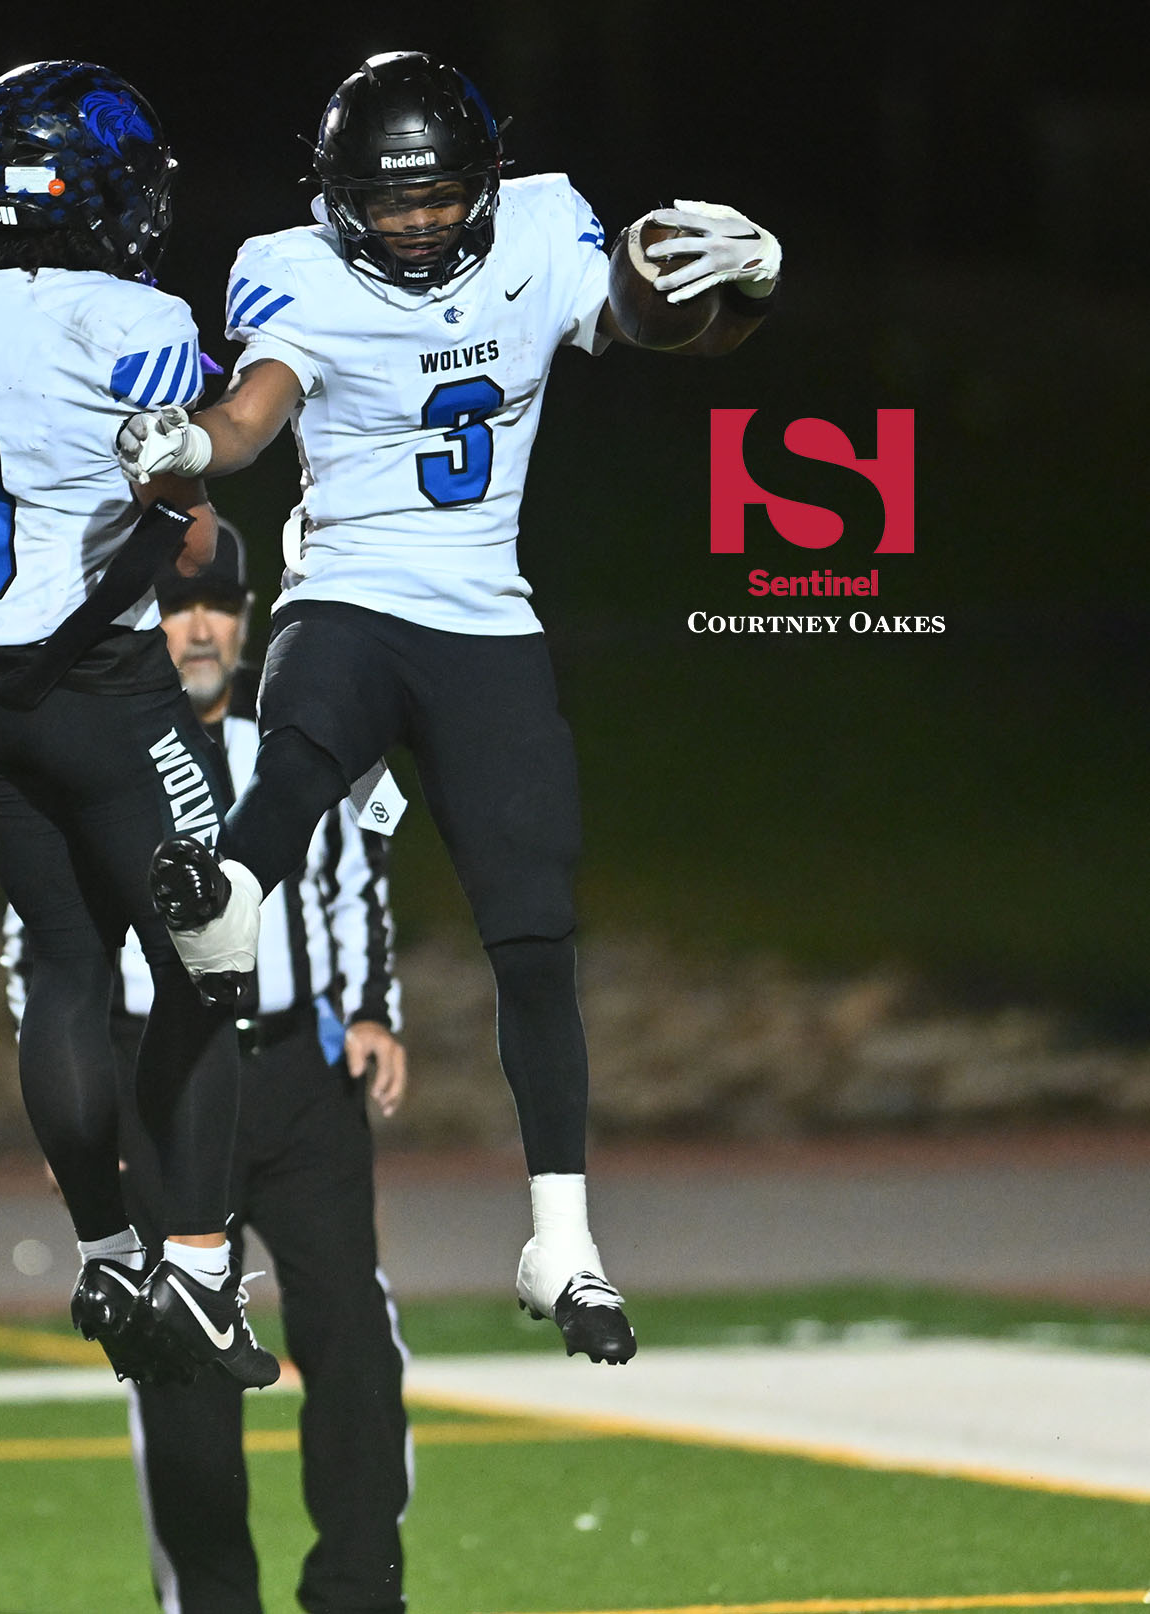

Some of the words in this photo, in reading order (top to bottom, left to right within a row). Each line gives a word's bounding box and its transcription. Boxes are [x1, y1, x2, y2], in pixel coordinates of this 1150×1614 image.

[381, 152, 436, 169] Riddell
[403, 270, 429, 279] Riddell
[419, 339, 500, 374] WOLVES
[416, 375, 505, 508] 3
[148, 726, 220, 857] WOLVE
